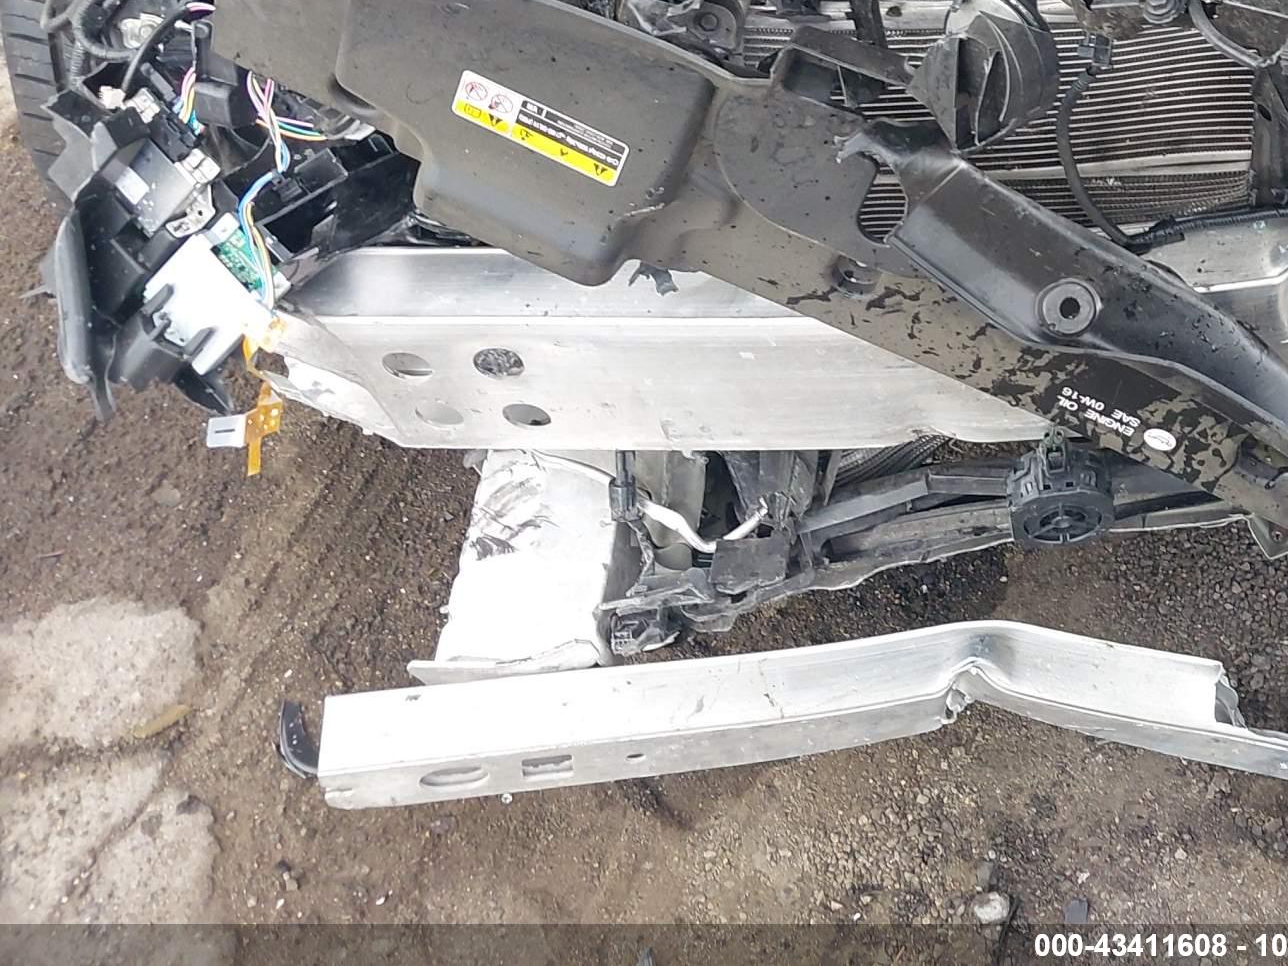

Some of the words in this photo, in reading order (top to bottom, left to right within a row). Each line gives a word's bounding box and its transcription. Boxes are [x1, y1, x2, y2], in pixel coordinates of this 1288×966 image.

[1057, 394, 1079, 411] OIL
[1084, 408, 1135, 436] ENGINE
[1111, 408, 1141, 428] SAE
